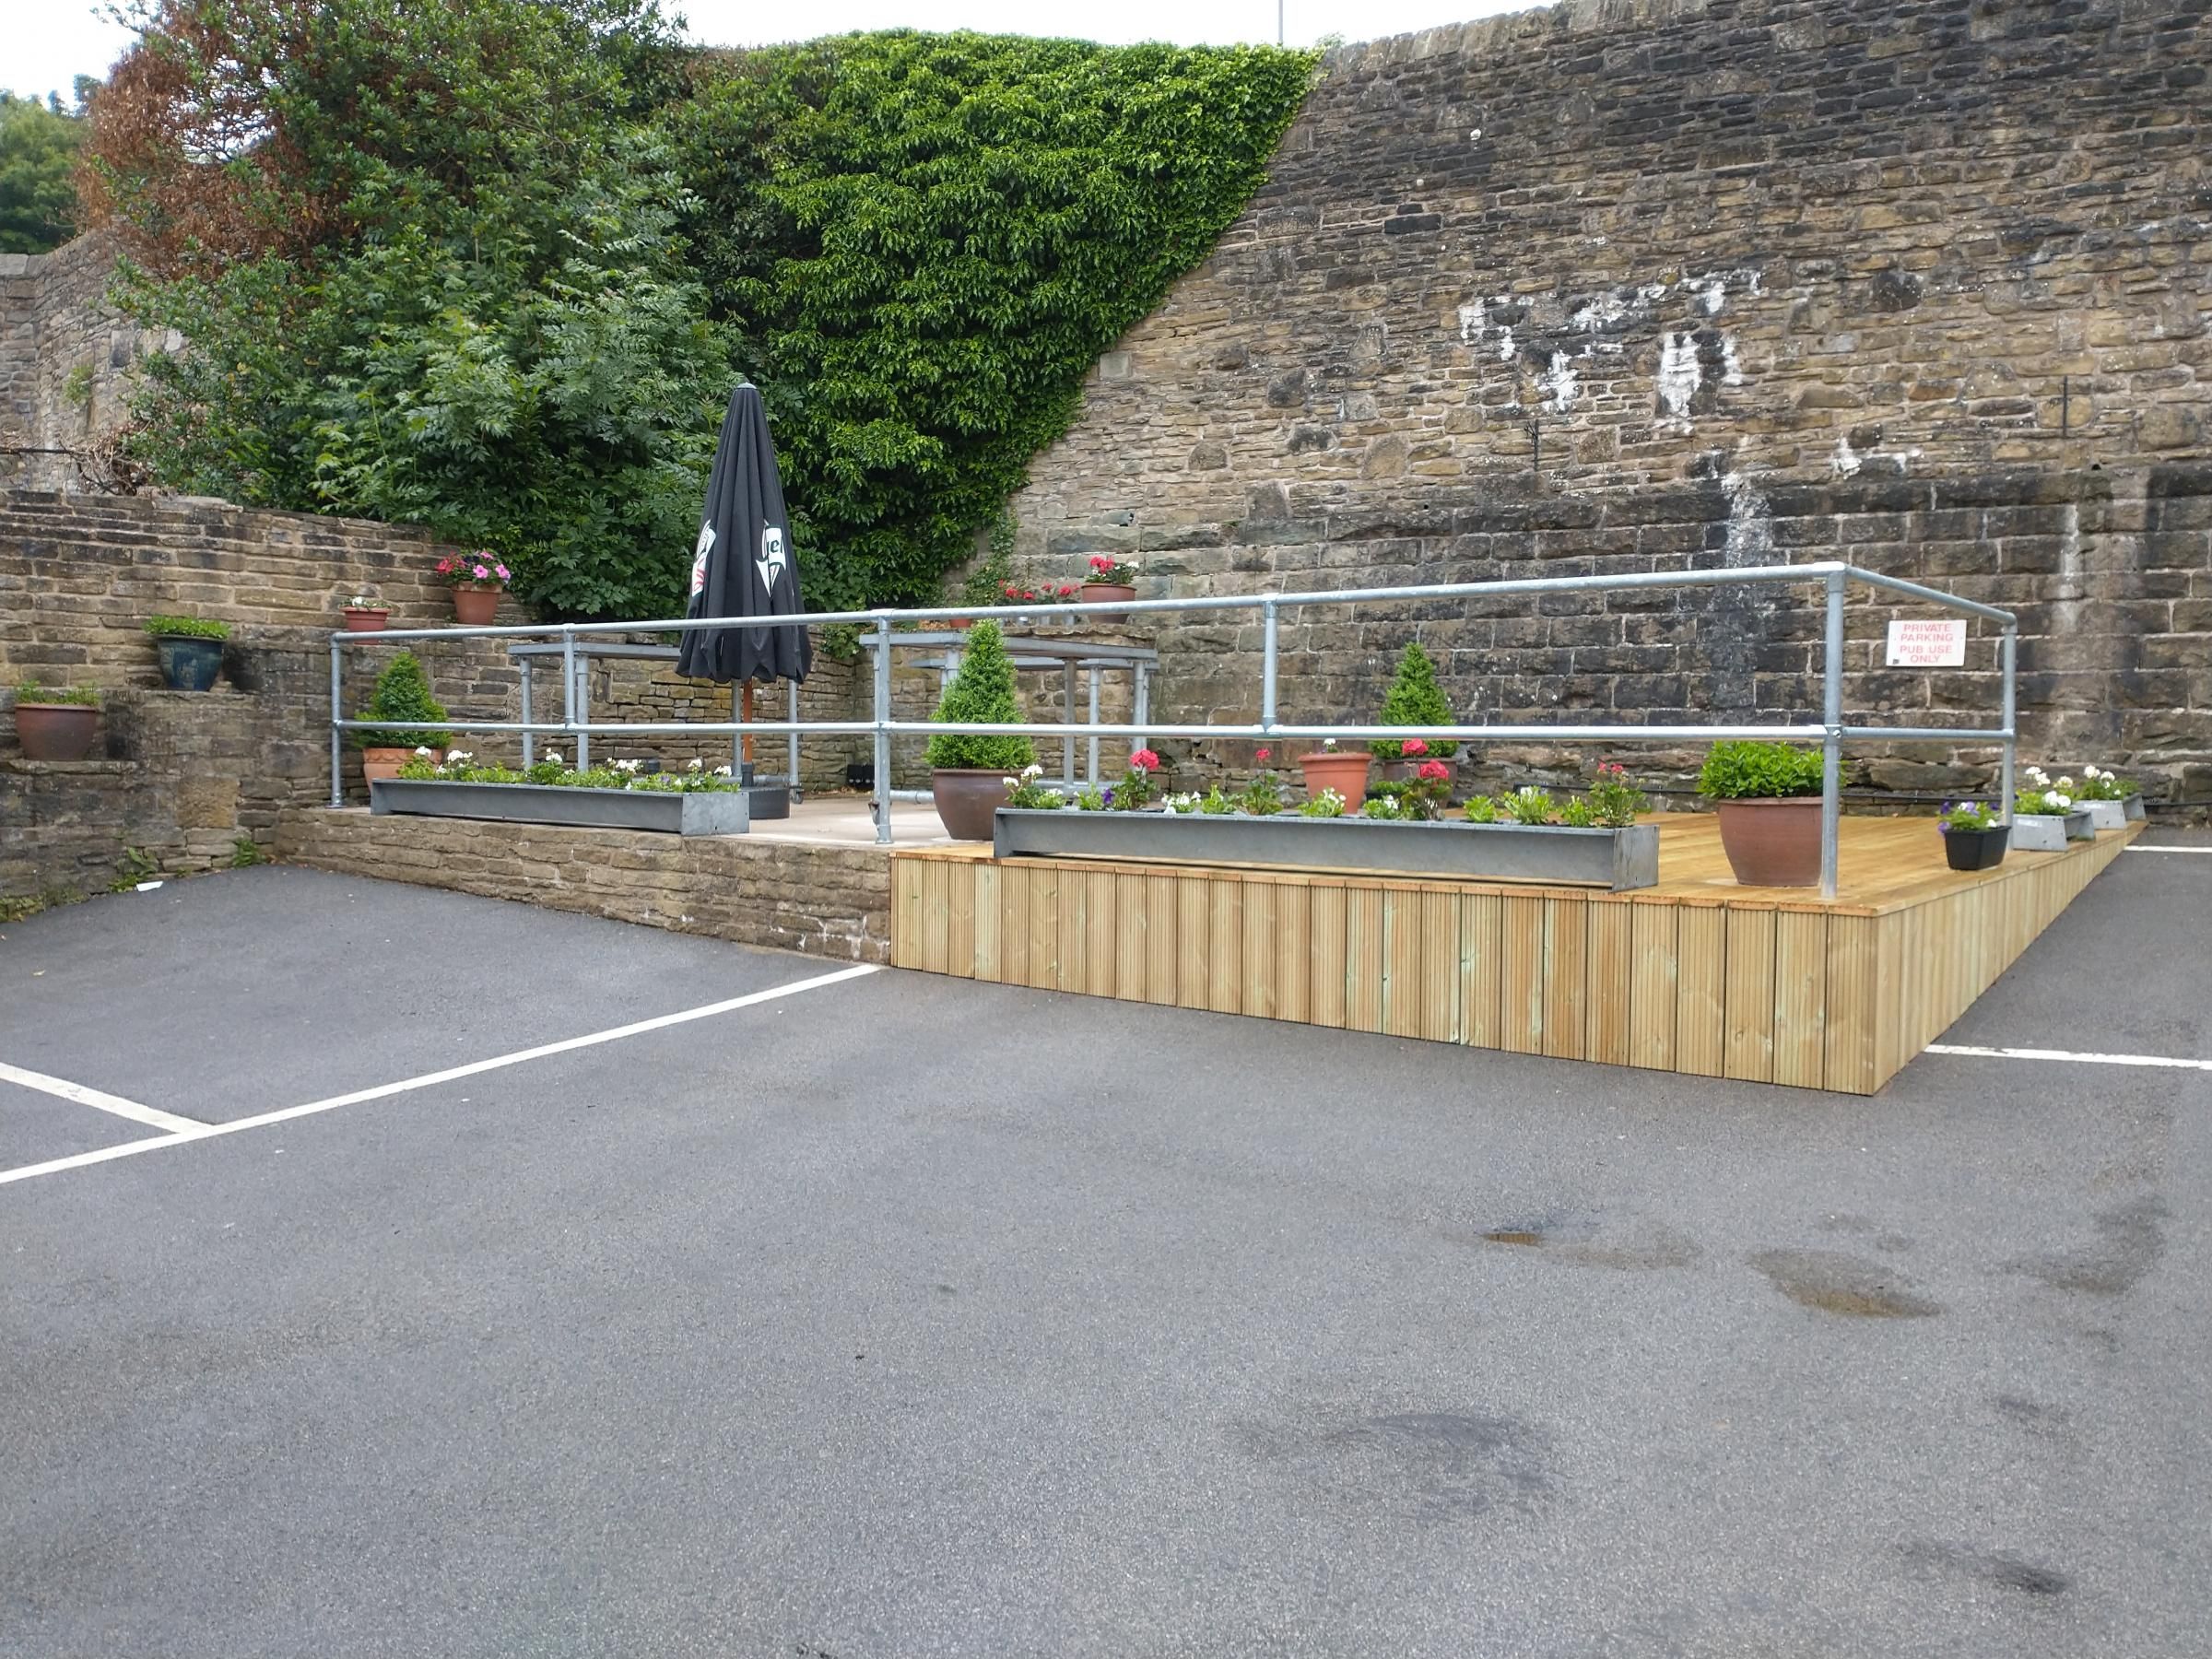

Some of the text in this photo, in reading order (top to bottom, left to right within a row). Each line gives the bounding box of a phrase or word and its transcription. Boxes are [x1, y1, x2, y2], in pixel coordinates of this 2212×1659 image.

[1903, 623, 1951, 631] PRIVATE
[1900, 633, 1953, 641] PARKING
[1900, 645, 1952, 653] PUB USE
[1910, 654, 1940, 663] ONLY
